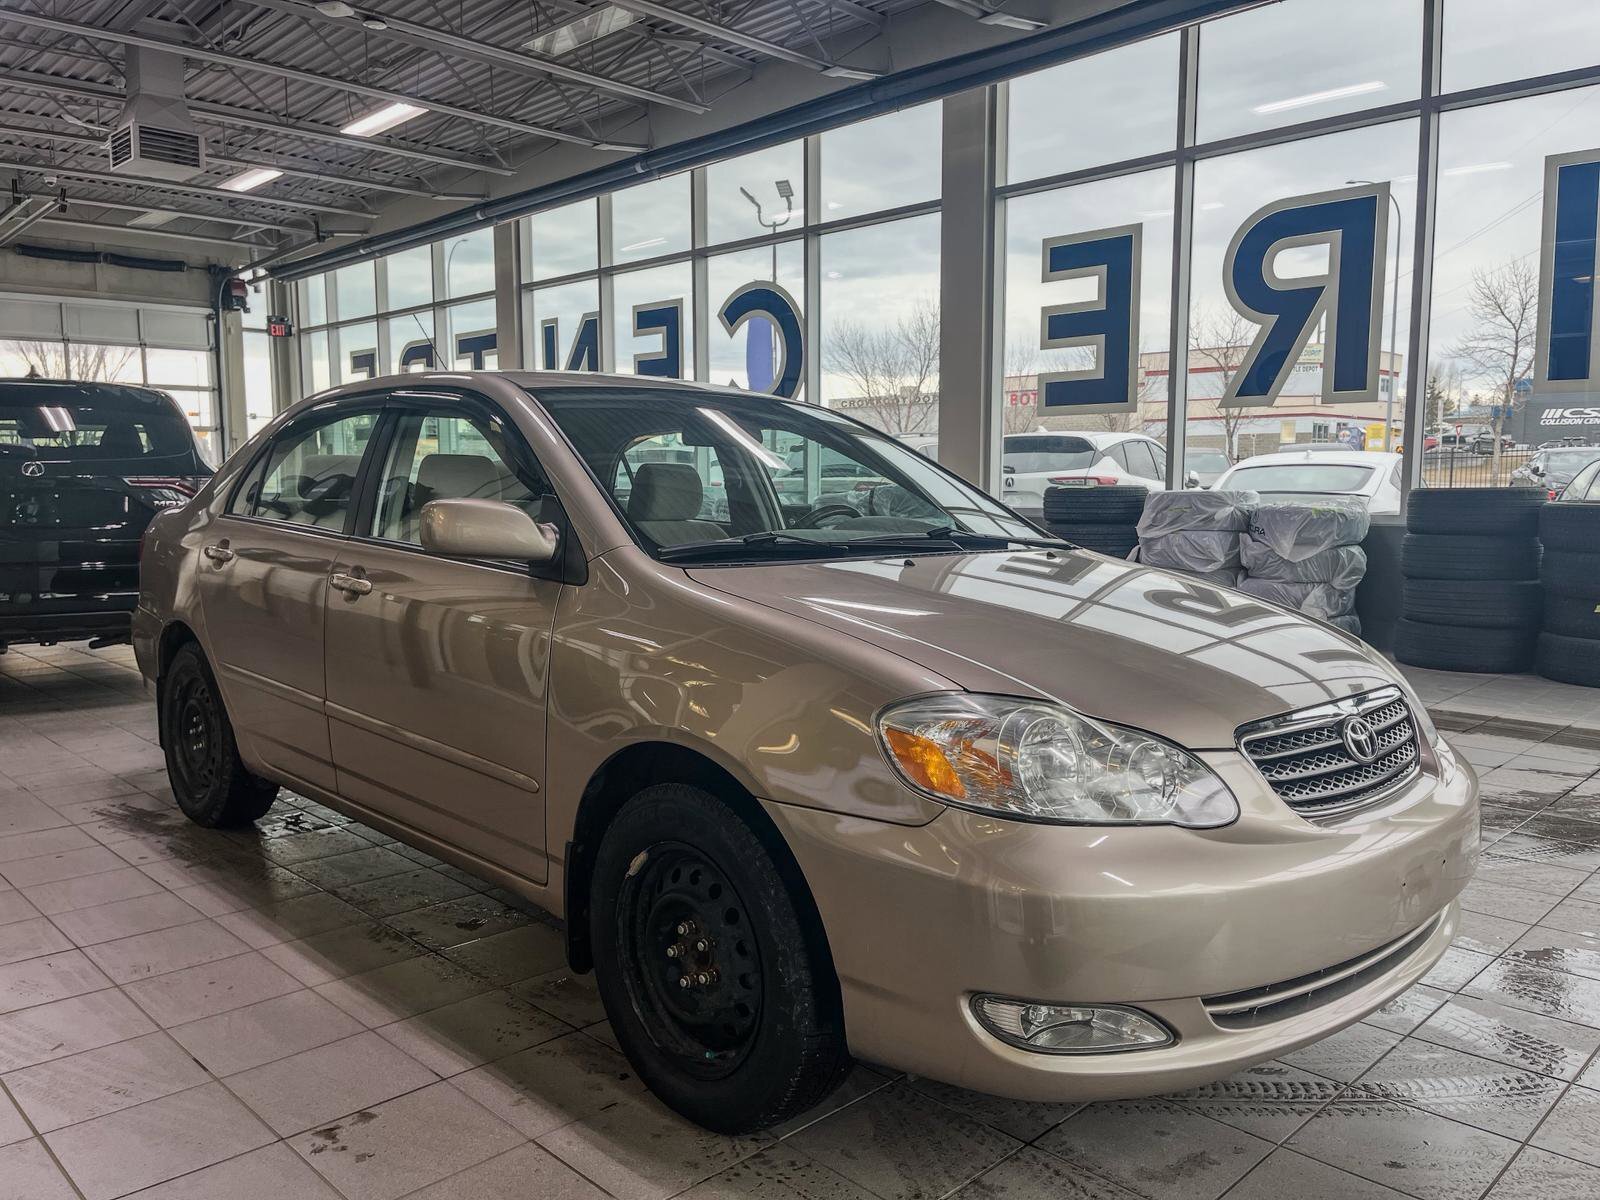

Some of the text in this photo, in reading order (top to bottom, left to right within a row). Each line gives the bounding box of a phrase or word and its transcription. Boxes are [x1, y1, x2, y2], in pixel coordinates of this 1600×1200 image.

[271, 324, 285, 336] EXIT
[1302, 365, 1318, 373] DEPOT
[1540, 418, 1583, 426] COLLISION
